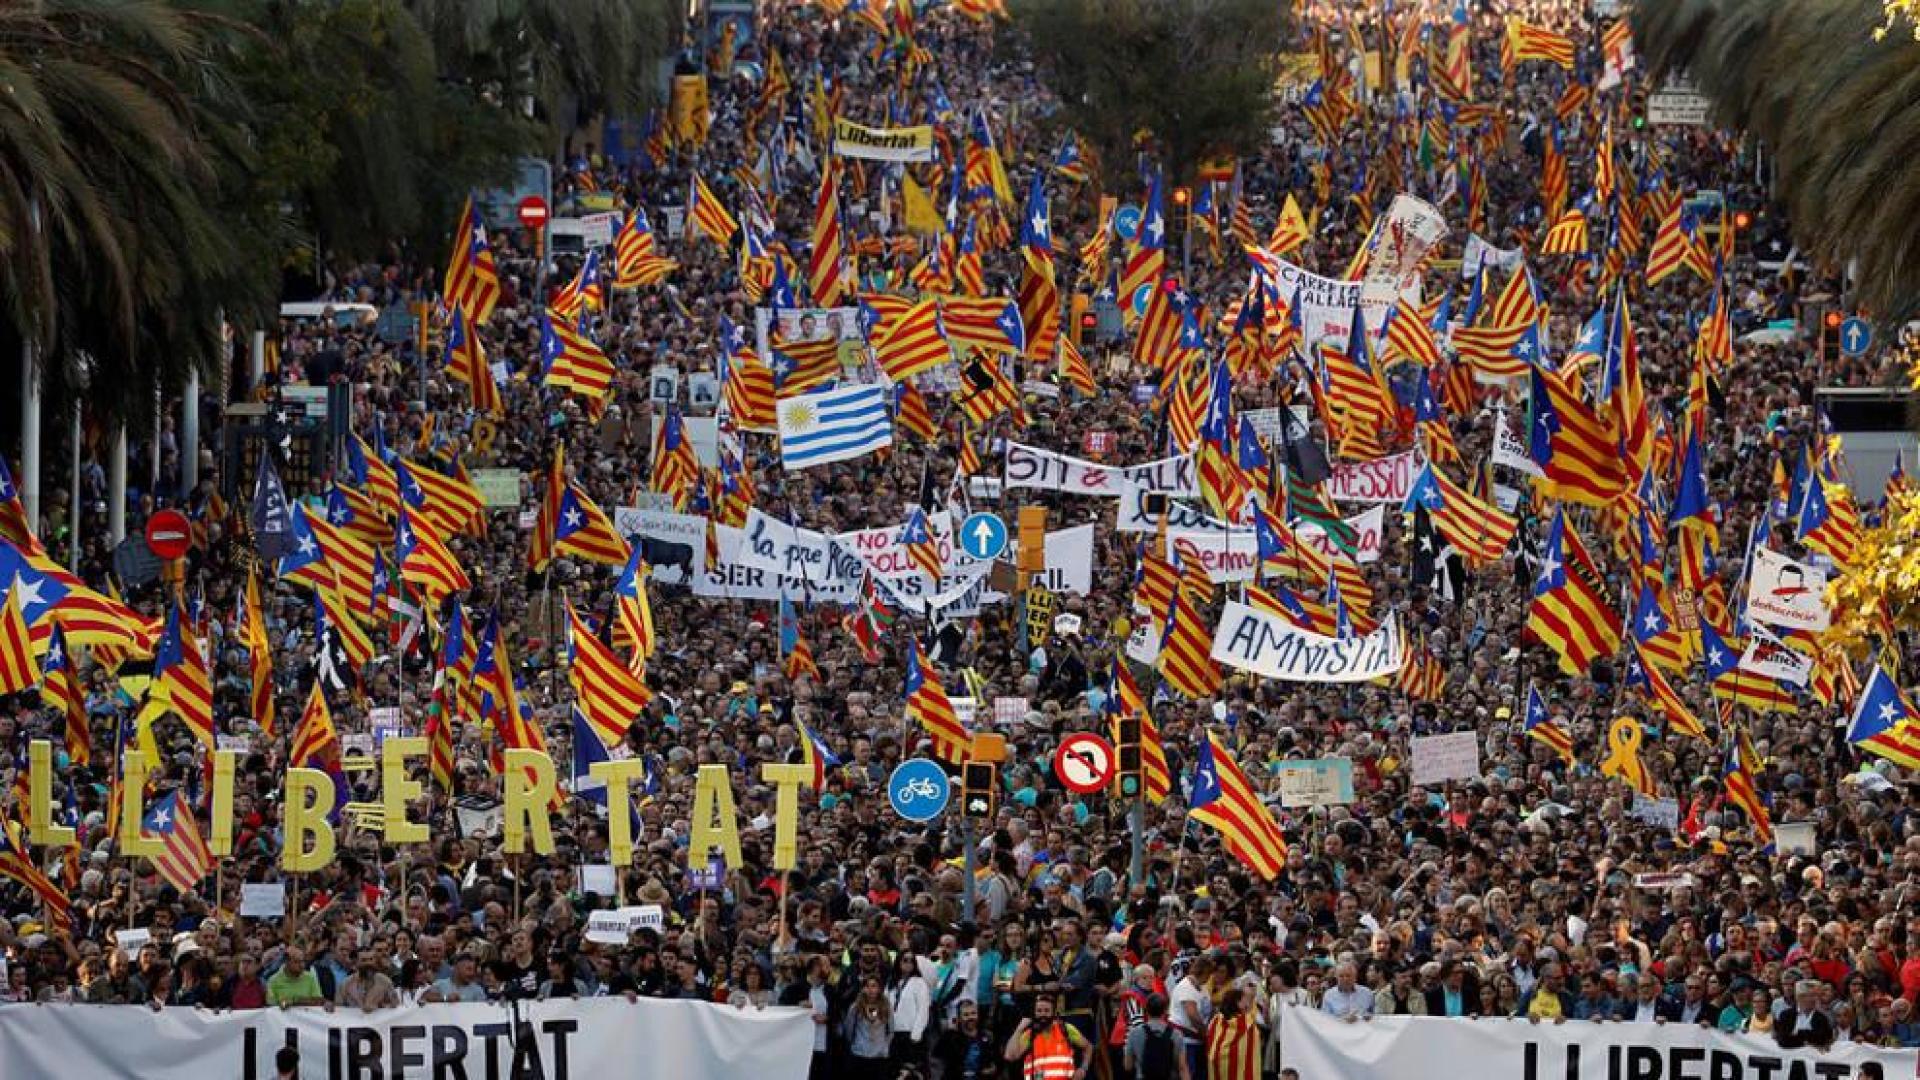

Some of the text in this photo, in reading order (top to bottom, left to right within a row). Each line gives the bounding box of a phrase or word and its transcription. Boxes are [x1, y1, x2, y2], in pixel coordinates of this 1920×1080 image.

[839, 122, 917, 148] Llibertat
[1080, 466, 1108, 489] &
[751, 519, 777, 560] la
[857, 532, 889, 550] NO
[710, 562, 764, 588] SER
[30, 737, 815, 873] LLIBERTAT
[1523, 1042, 1851, 1080] LLIBER
